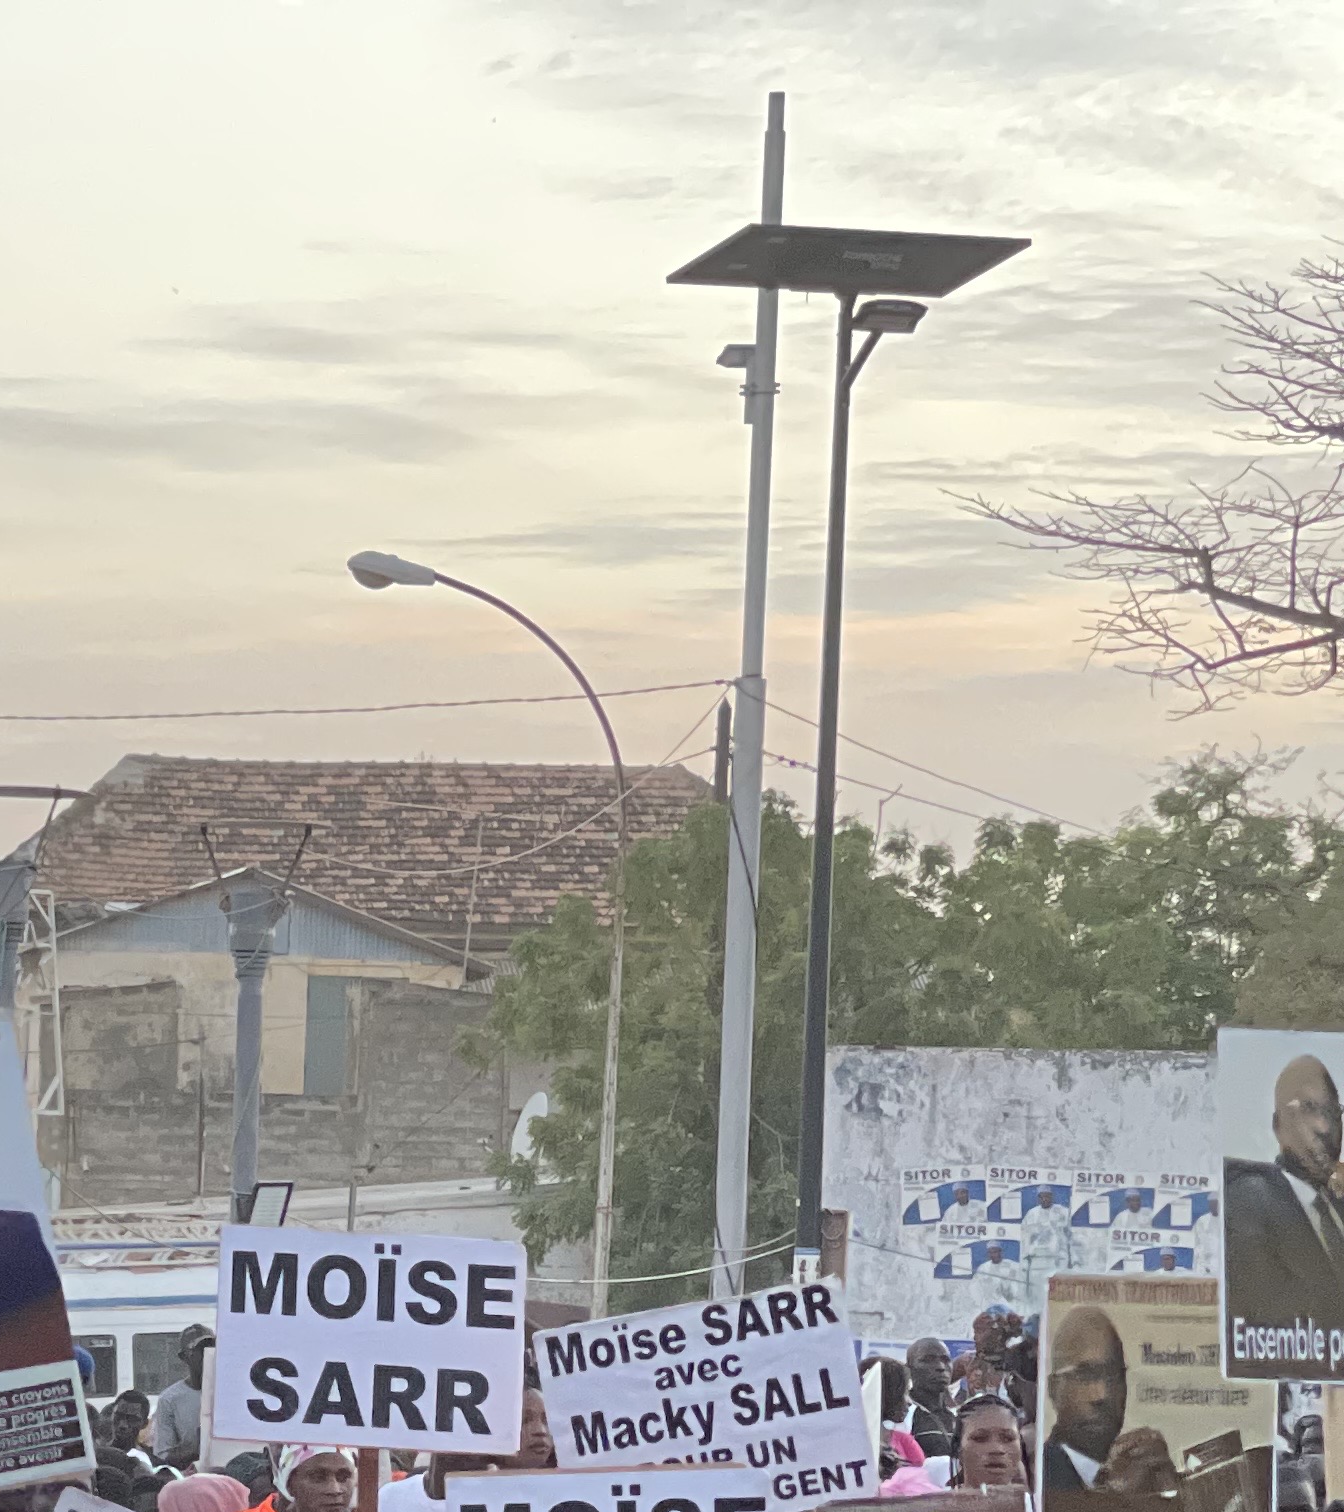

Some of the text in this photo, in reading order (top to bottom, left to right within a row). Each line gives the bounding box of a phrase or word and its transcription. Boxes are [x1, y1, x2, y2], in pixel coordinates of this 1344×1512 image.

[903, 1168, 951, 1181] SITOR
[989, 1167, 1038, 1181] SITOR
[1076, 1172, 1126, 1184] SITOR
[1161, 1173, 1210, 1187] SITOR
[939, 1223, 987, 1236] SITOR
[1112, 1229, 1161, 1243] SITOR
[230, 1243, 516, 1330] MOÏSE
[545, 1284, 840, 1377] Moïse SARR
[1233, 1316, 1325, 1360] Ensemble
[654, 1354, 743, 1391] avec
[11, 1383, 69, 1406] croyons
[246, 1357, 492, 1435] SARR
[11, 1403, 67, 1430] progrès
[570, 1368, 850, 1457] Macky SALL
[18, 1446, 64, 1465] avenir
[746, 1436, 797, 1468] UN
[773, 1459, 868, 1500] GENT
